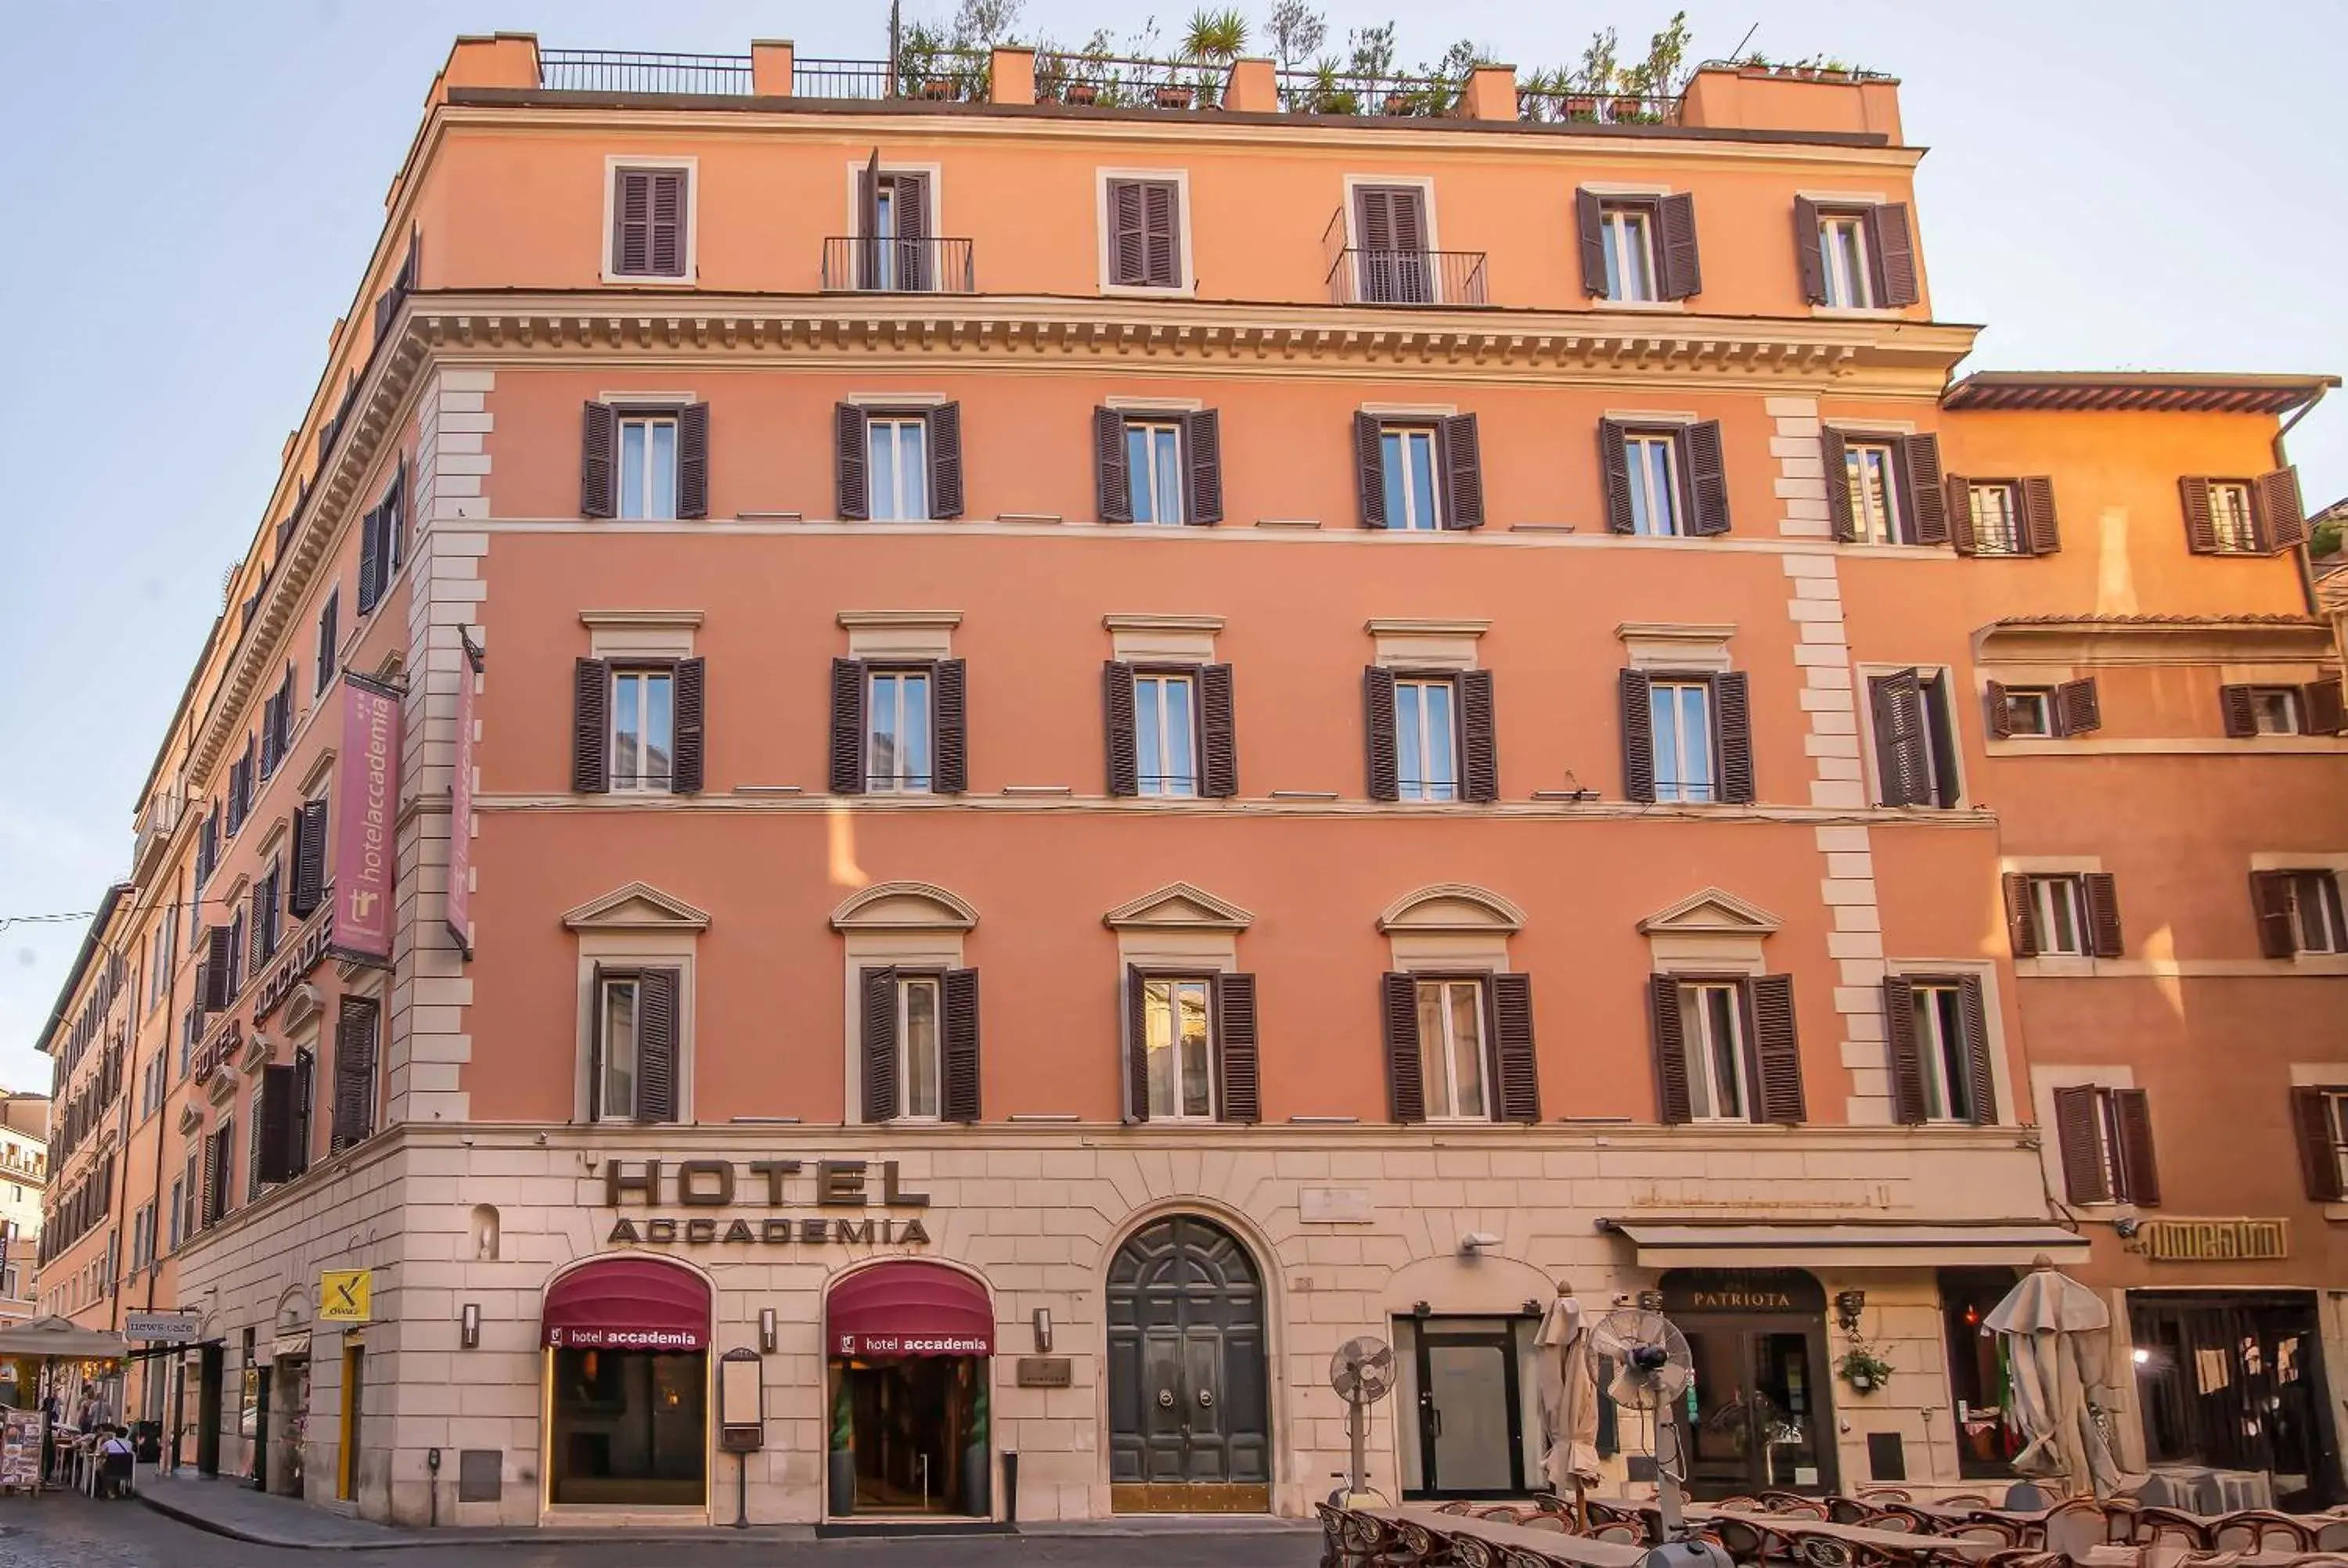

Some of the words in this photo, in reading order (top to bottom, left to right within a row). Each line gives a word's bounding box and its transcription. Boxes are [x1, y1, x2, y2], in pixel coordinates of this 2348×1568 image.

[357, 696, 388, 883] hotelaccademia
[195, 1019, 242, 1083] HOTEL
[606, 1159, 931, 1207] HOTEL
[607, 1218, 931, 1244] ACCADEMIA
[1693, 1293, 1791, 1306] PATRIOTA
[572, 1330, 602, 1343] hotel
[607, 1331, 696, 1345] accademia
[866, 1337, 898, 1350] hotel
[904, 1337, 987, 1350] accademia
